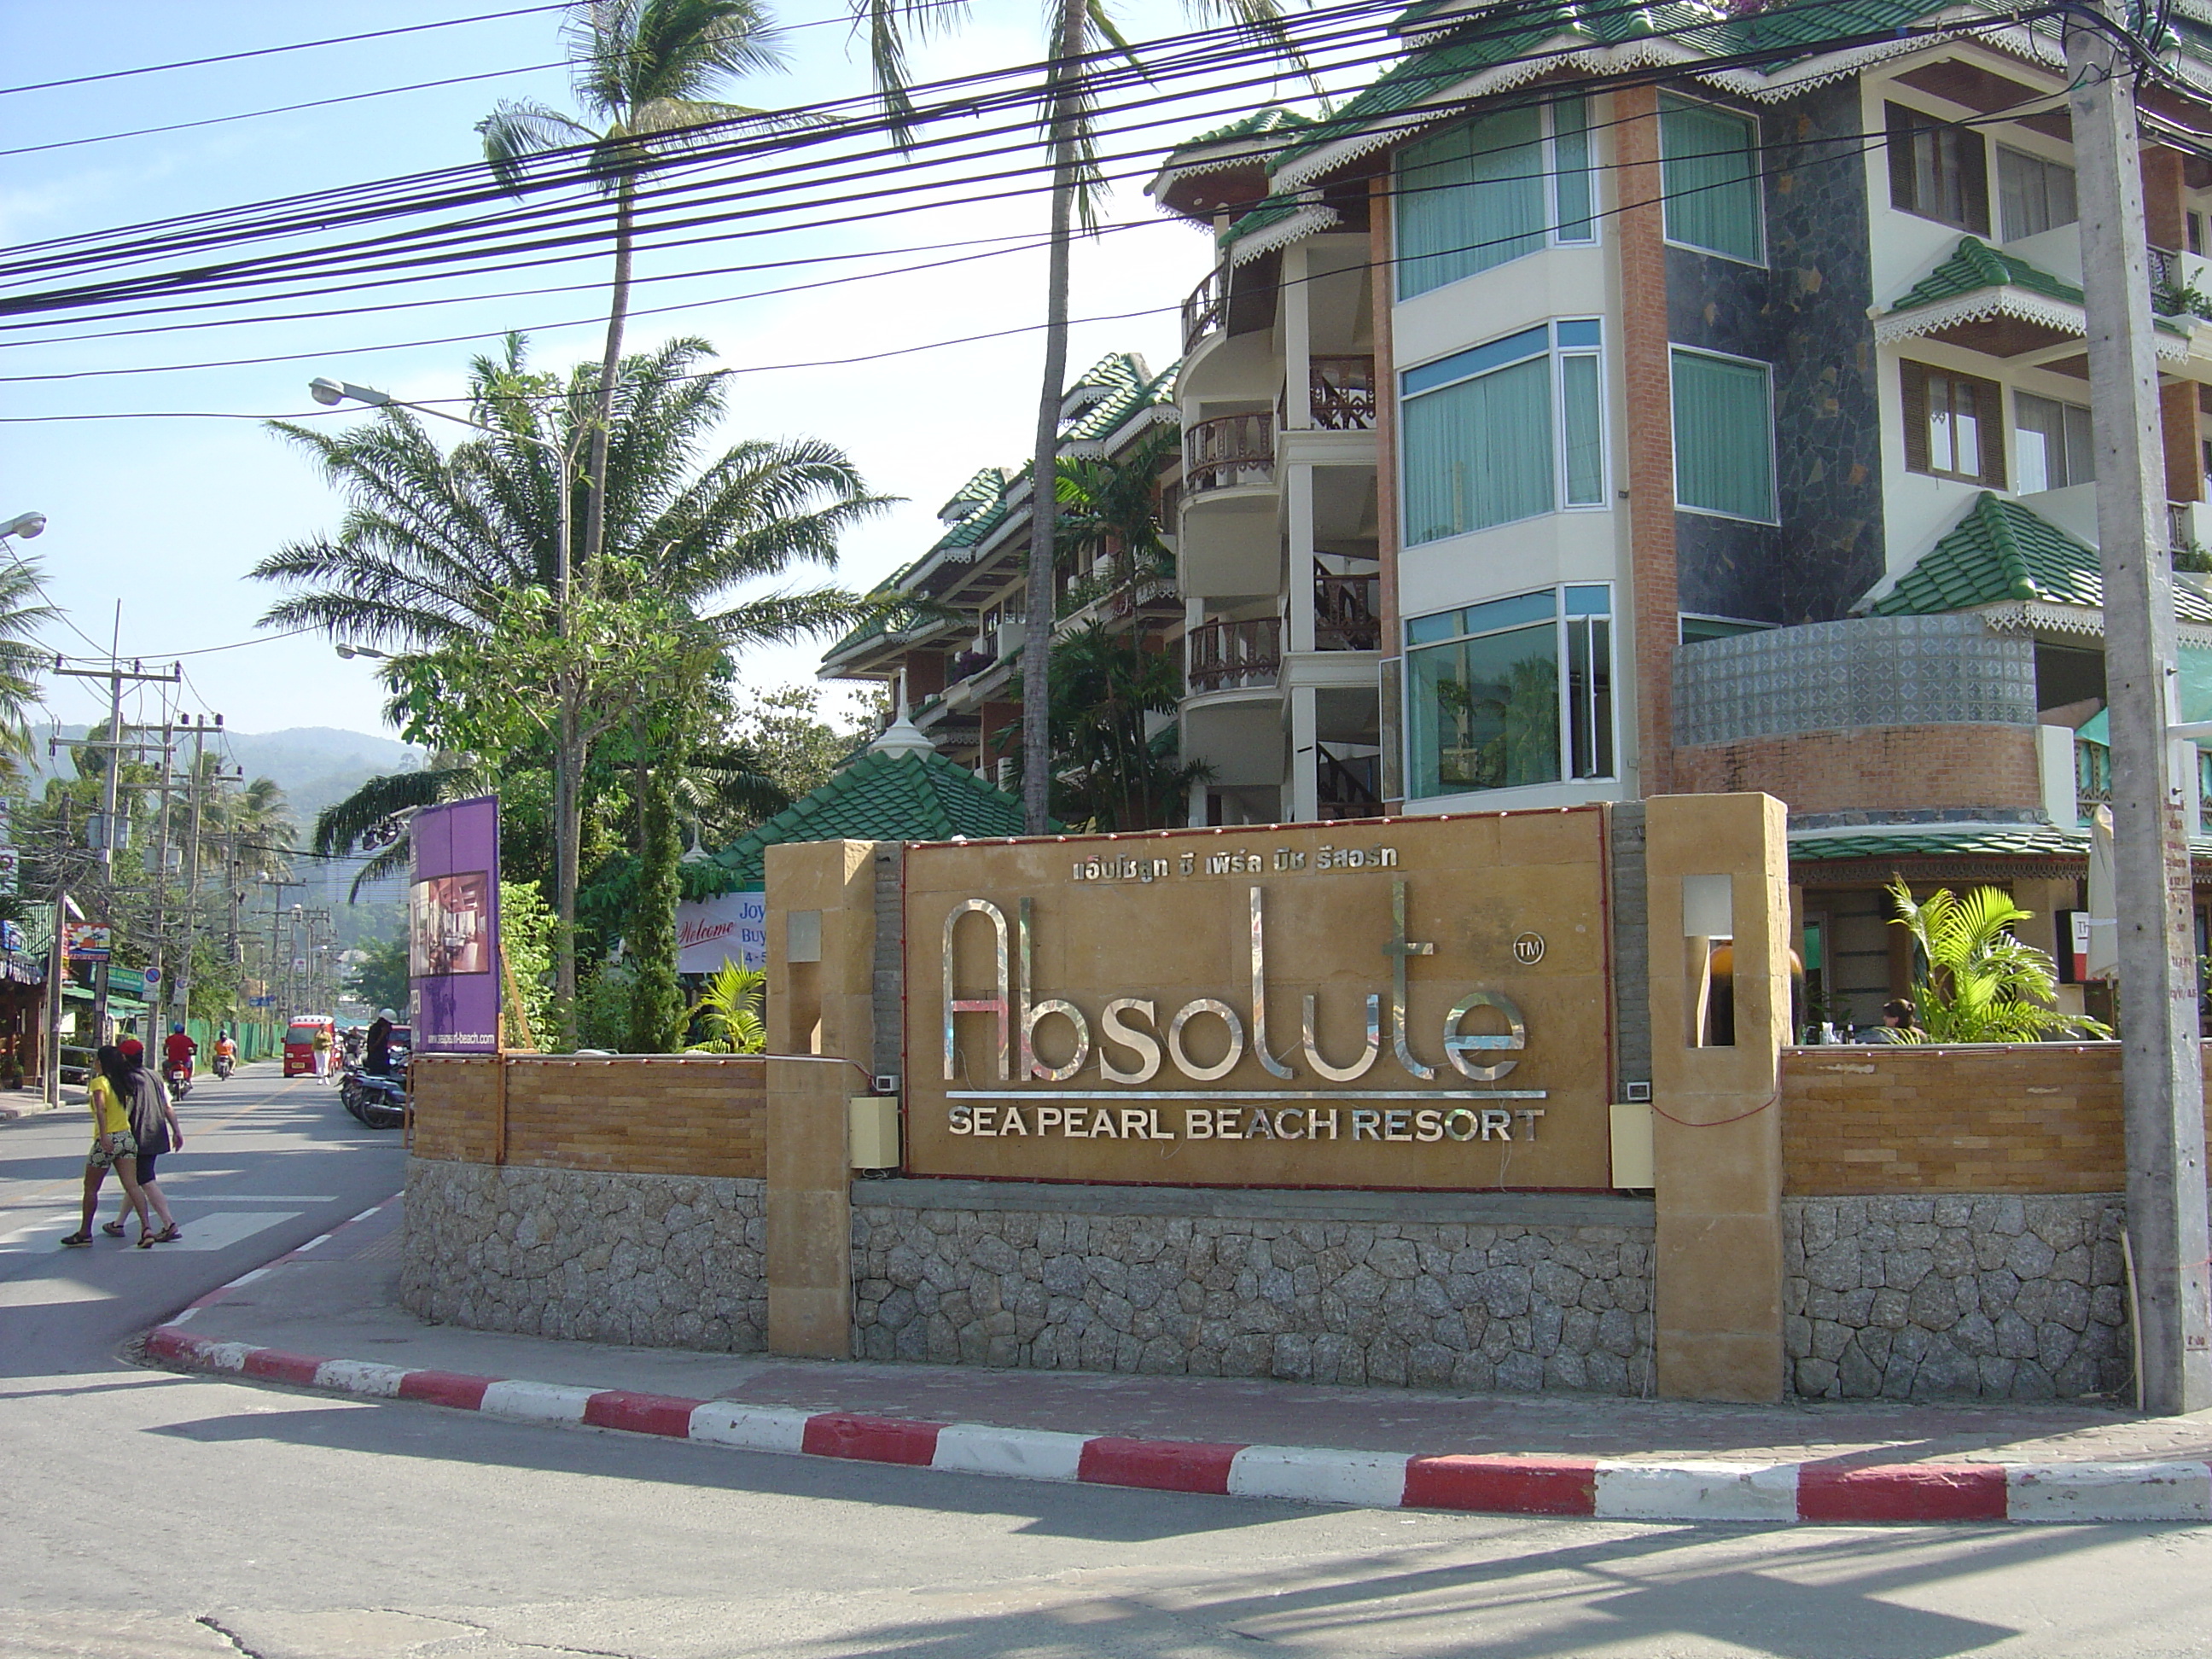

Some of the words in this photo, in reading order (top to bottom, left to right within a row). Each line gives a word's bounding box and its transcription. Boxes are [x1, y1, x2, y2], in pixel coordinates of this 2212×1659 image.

[678, 918, 735, 944] Welcome
[942, 880, 1526, 1084] Absolute
[949, 1107, 1027, 1137] SEA
[1037, 1107, 1174, 1139] PEARL
[1185, 1108, 1338, 1141] BEACH
[1352, 1109, 1545, 1142] RESORT
